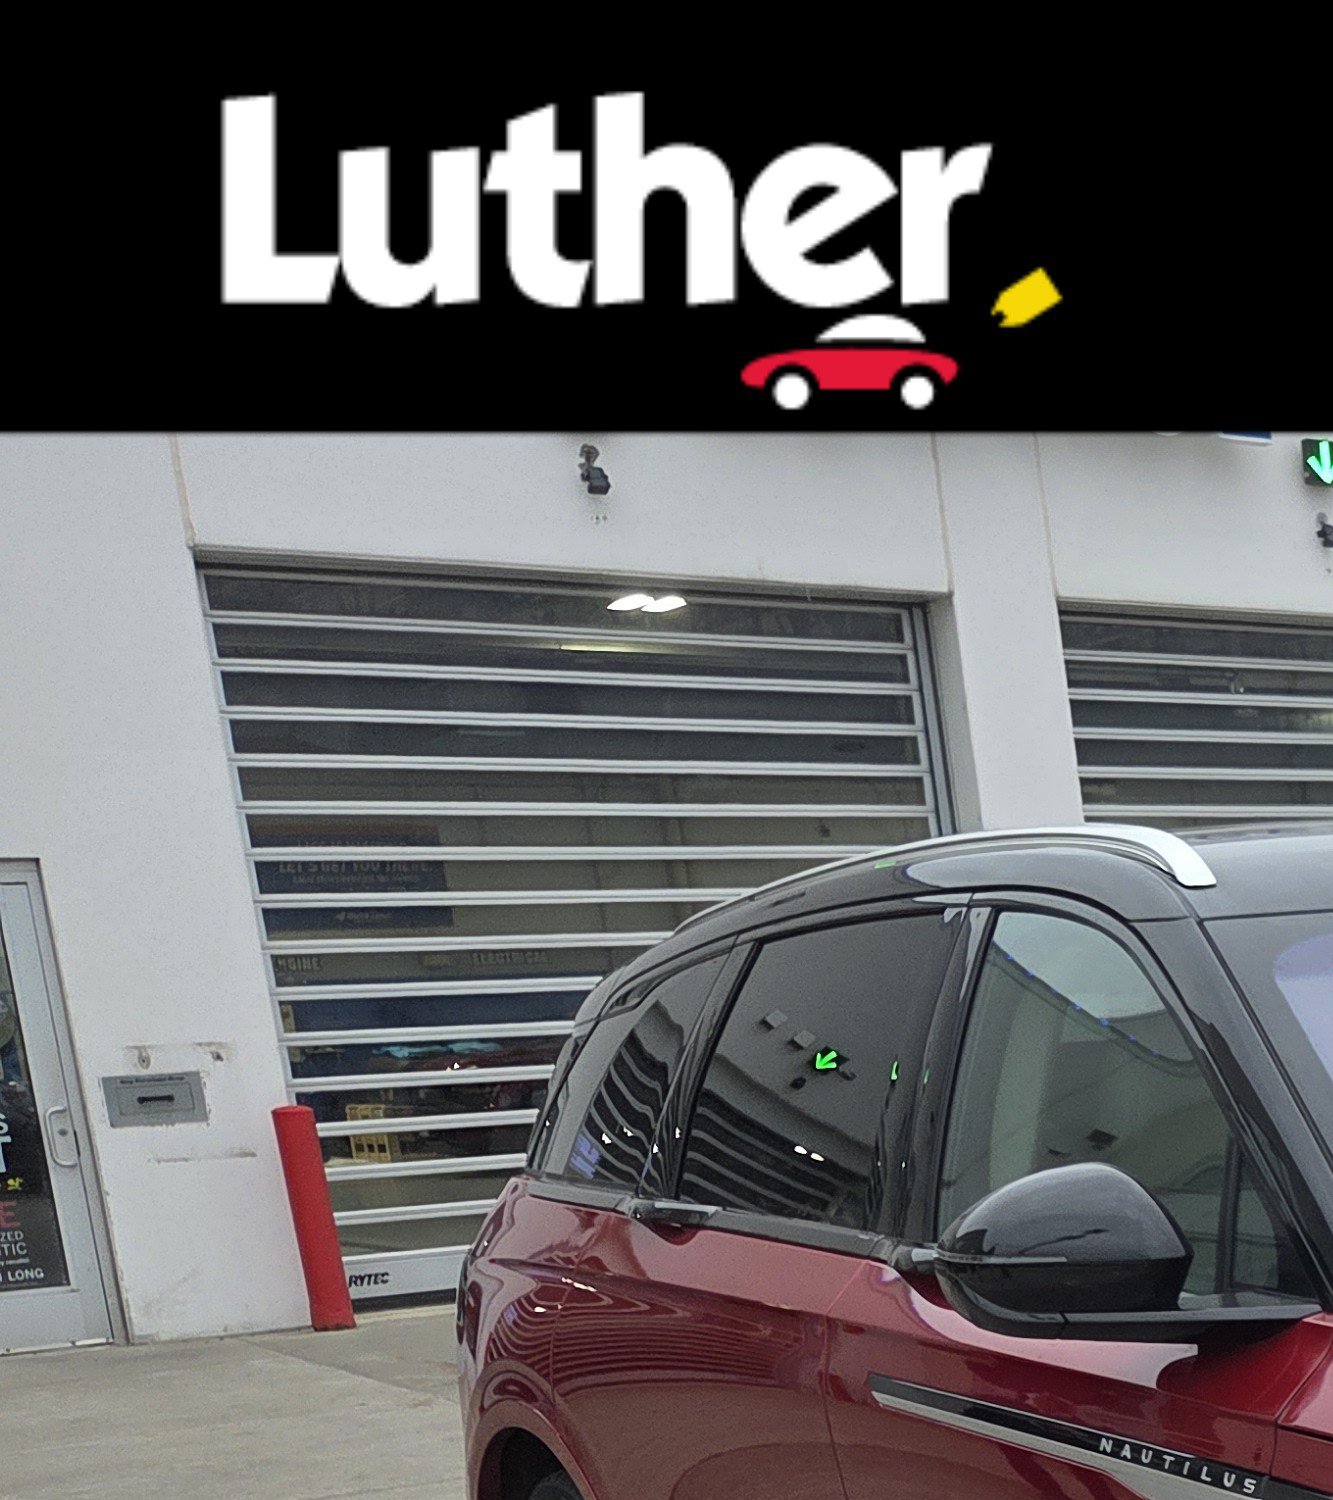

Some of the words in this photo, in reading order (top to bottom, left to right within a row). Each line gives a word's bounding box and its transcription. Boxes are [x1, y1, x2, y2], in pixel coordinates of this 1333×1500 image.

[7, 1267, 45, 1282] LONG
[348, 1271, 390, 1288] RYTEC
[1100, 1437, 1258, 1494] NAUTILUS
